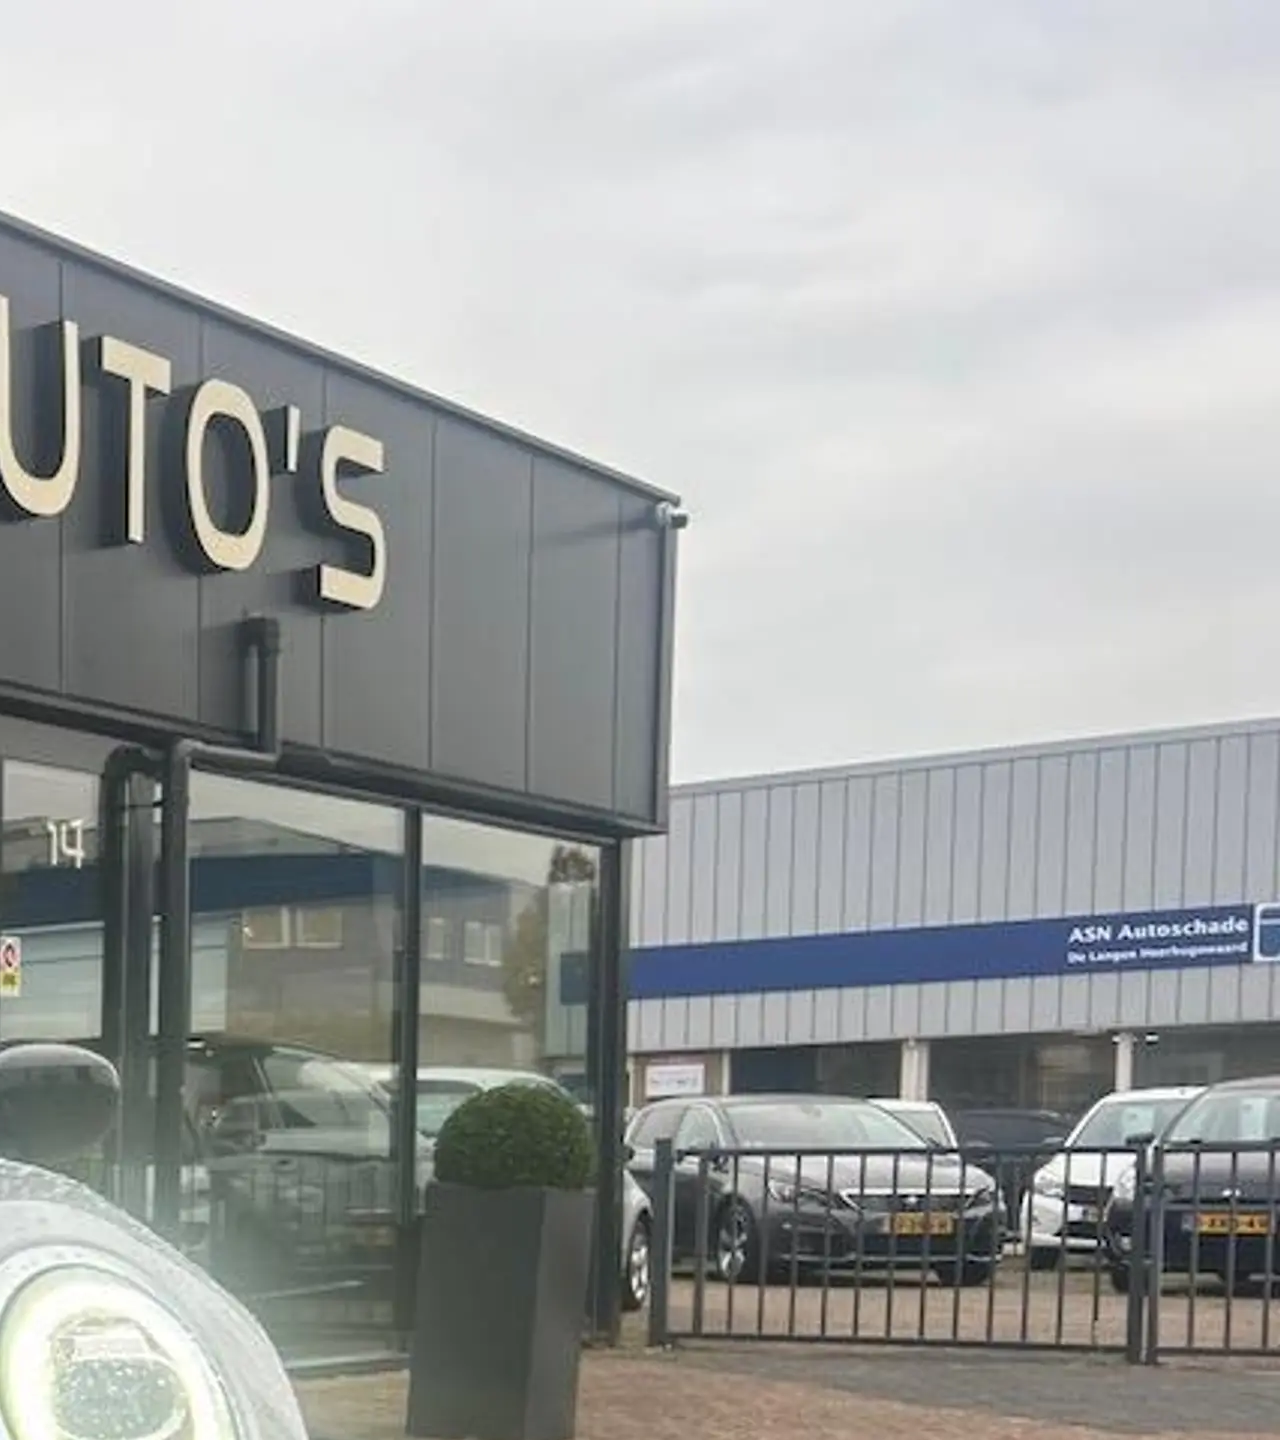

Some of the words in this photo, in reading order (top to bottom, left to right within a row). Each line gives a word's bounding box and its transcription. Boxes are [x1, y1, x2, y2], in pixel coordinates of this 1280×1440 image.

[46, 819, 85, 869] 14
[1068, 925, 1112, 944] ASN
[1117, 916, 1249, 939] Autoschade
